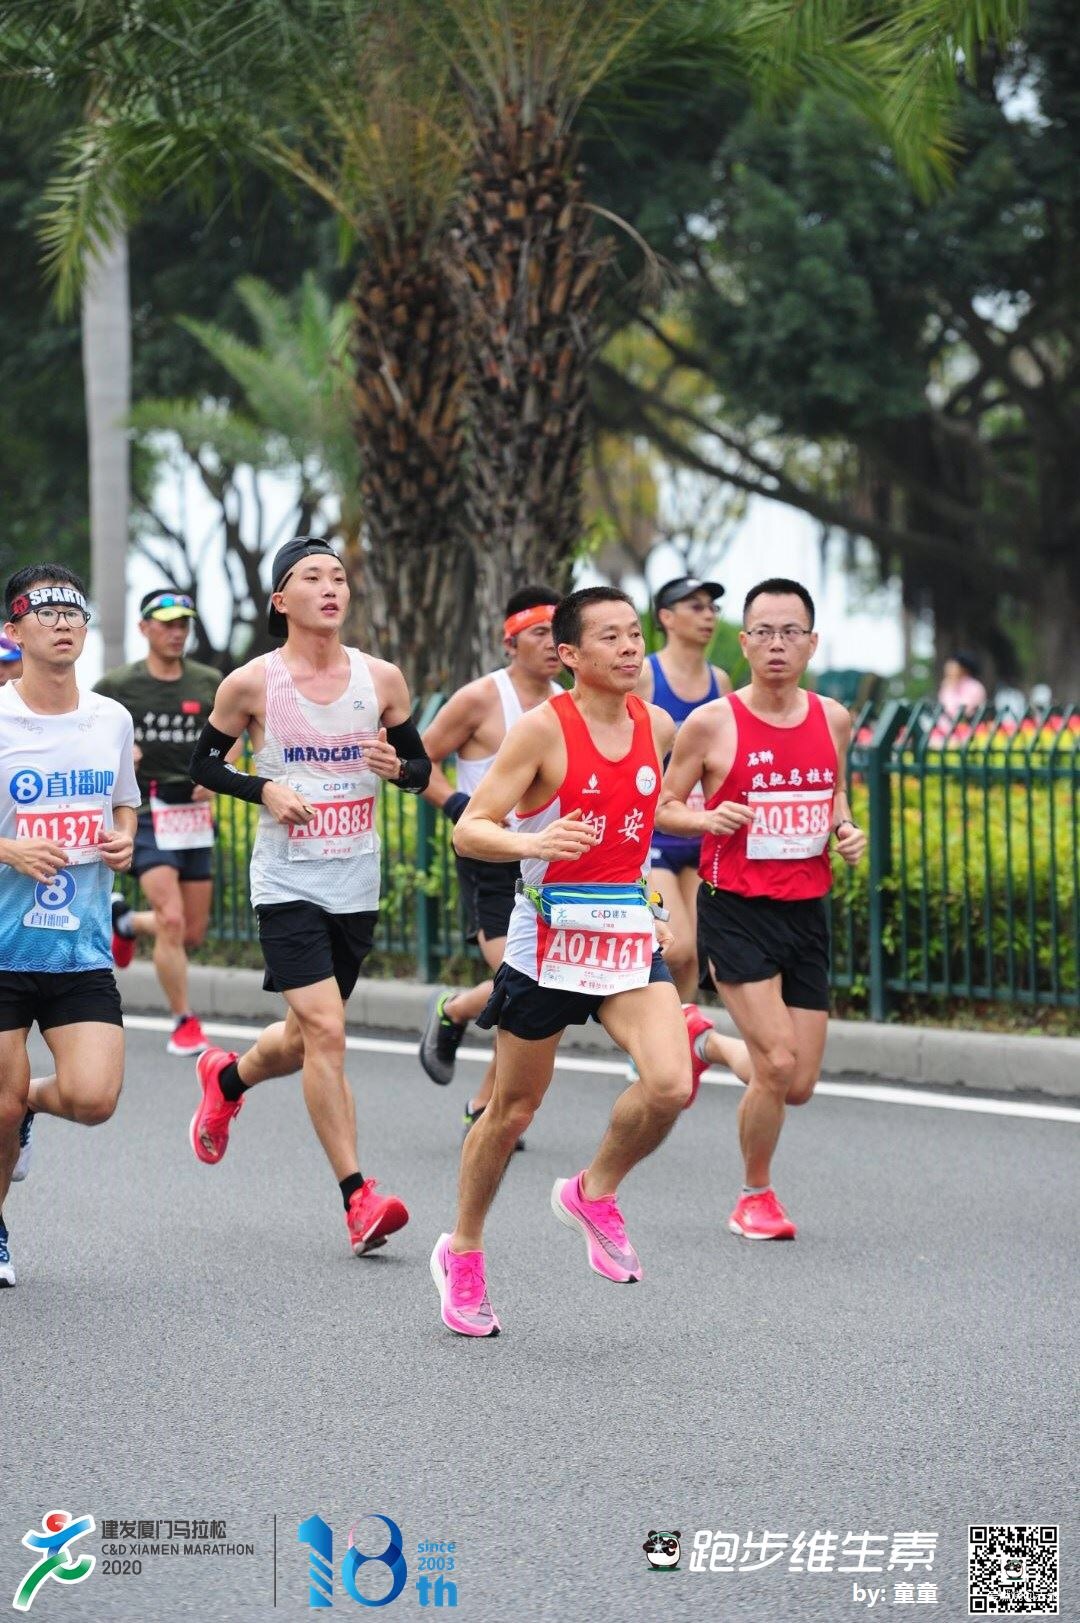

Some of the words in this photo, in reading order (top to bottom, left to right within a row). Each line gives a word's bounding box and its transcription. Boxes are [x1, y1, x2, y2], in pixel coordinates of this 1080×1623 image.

[284, 745, 364, 763] HARDCOR
[46, 769, 114, 797] 直播吧
[16, 814, 104, 847] A01327
[751, 804, 829, 835] A01388
[31, 912, 69, 927] 直播吧
[547, 930, 646, 970] A01161
